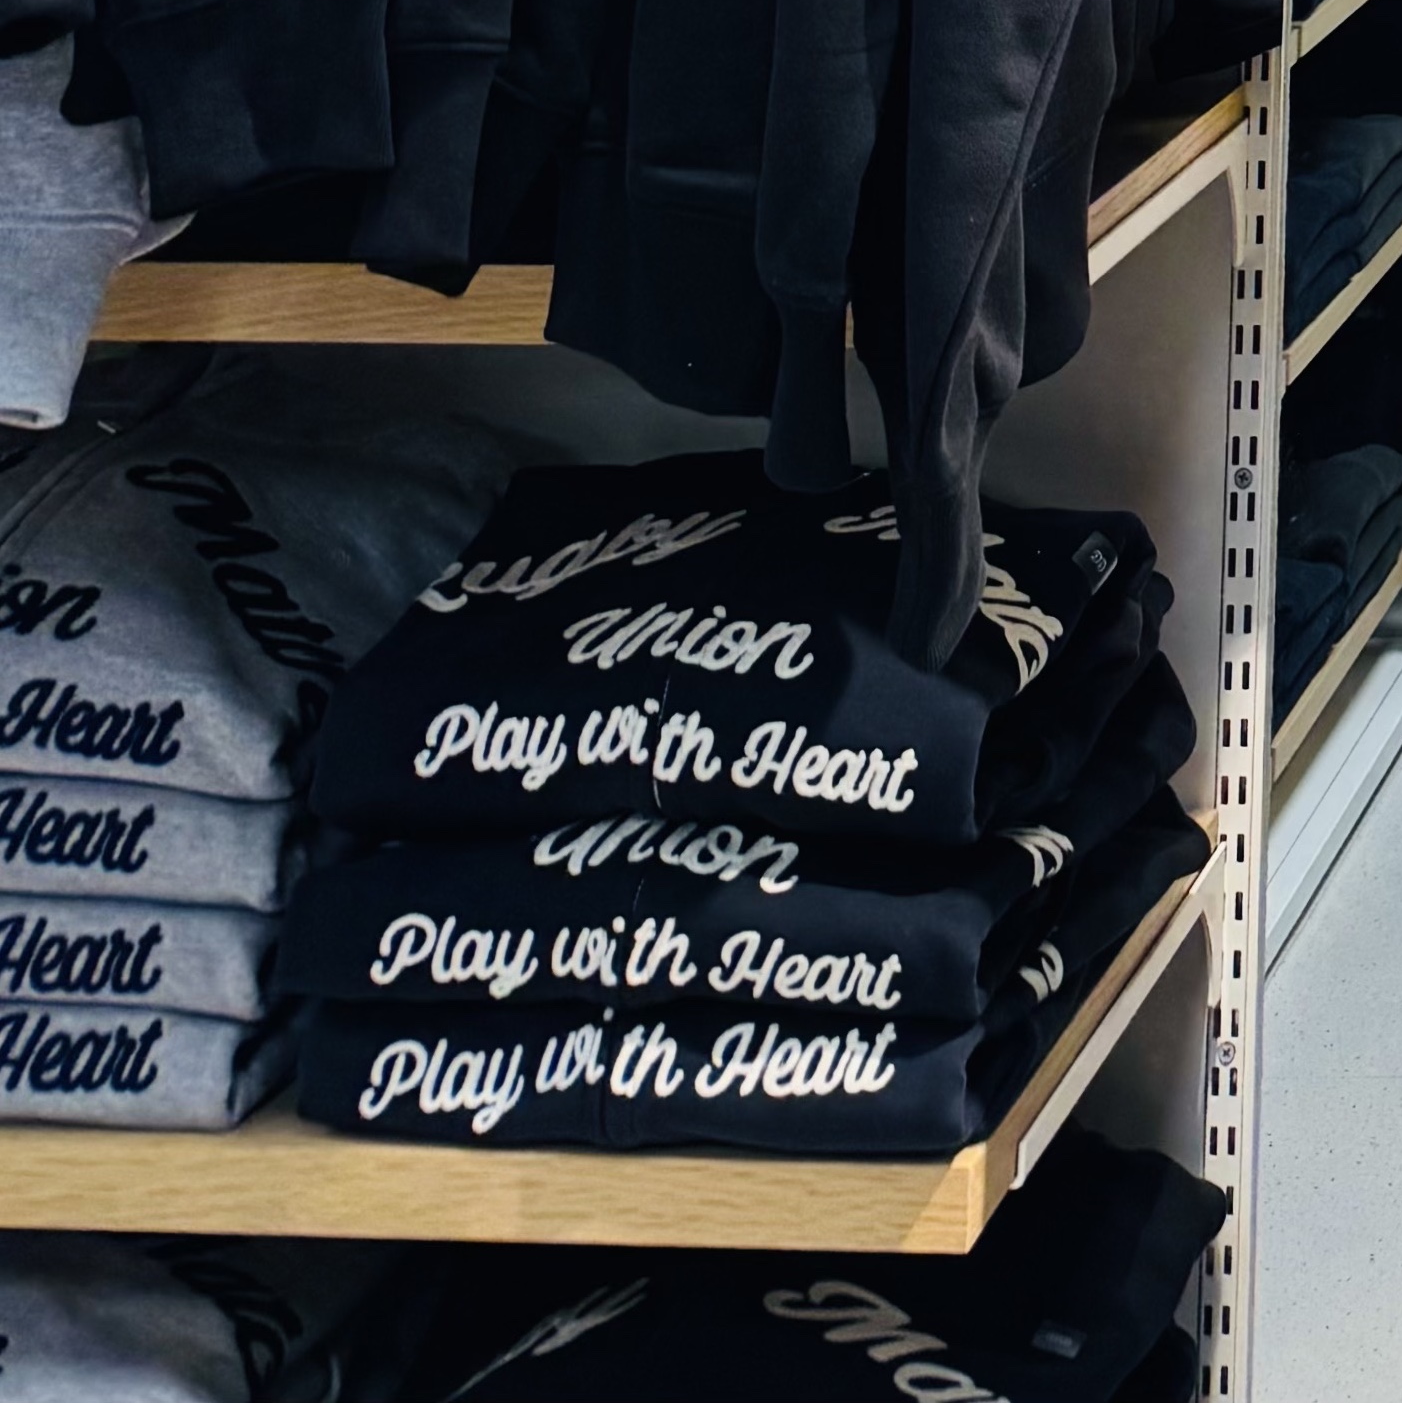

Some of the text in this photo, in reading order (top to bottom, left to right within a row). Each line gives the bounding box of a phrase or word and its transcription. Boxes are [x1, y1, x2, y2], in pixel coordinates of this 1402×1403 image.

[562, 601, 814, 679] Union
[0, 678, 186, 767] Heart
[414, 697, 920, 813] Play with Heart
[0, 788, 155, 873] Heart
[0, 915, 163, 993] Heart
[371, 911, 903, 1012] Play with Heart
[0, 1012, 163, 1093] Heart
[360, 1009, 896, 1134] Play with Heart
